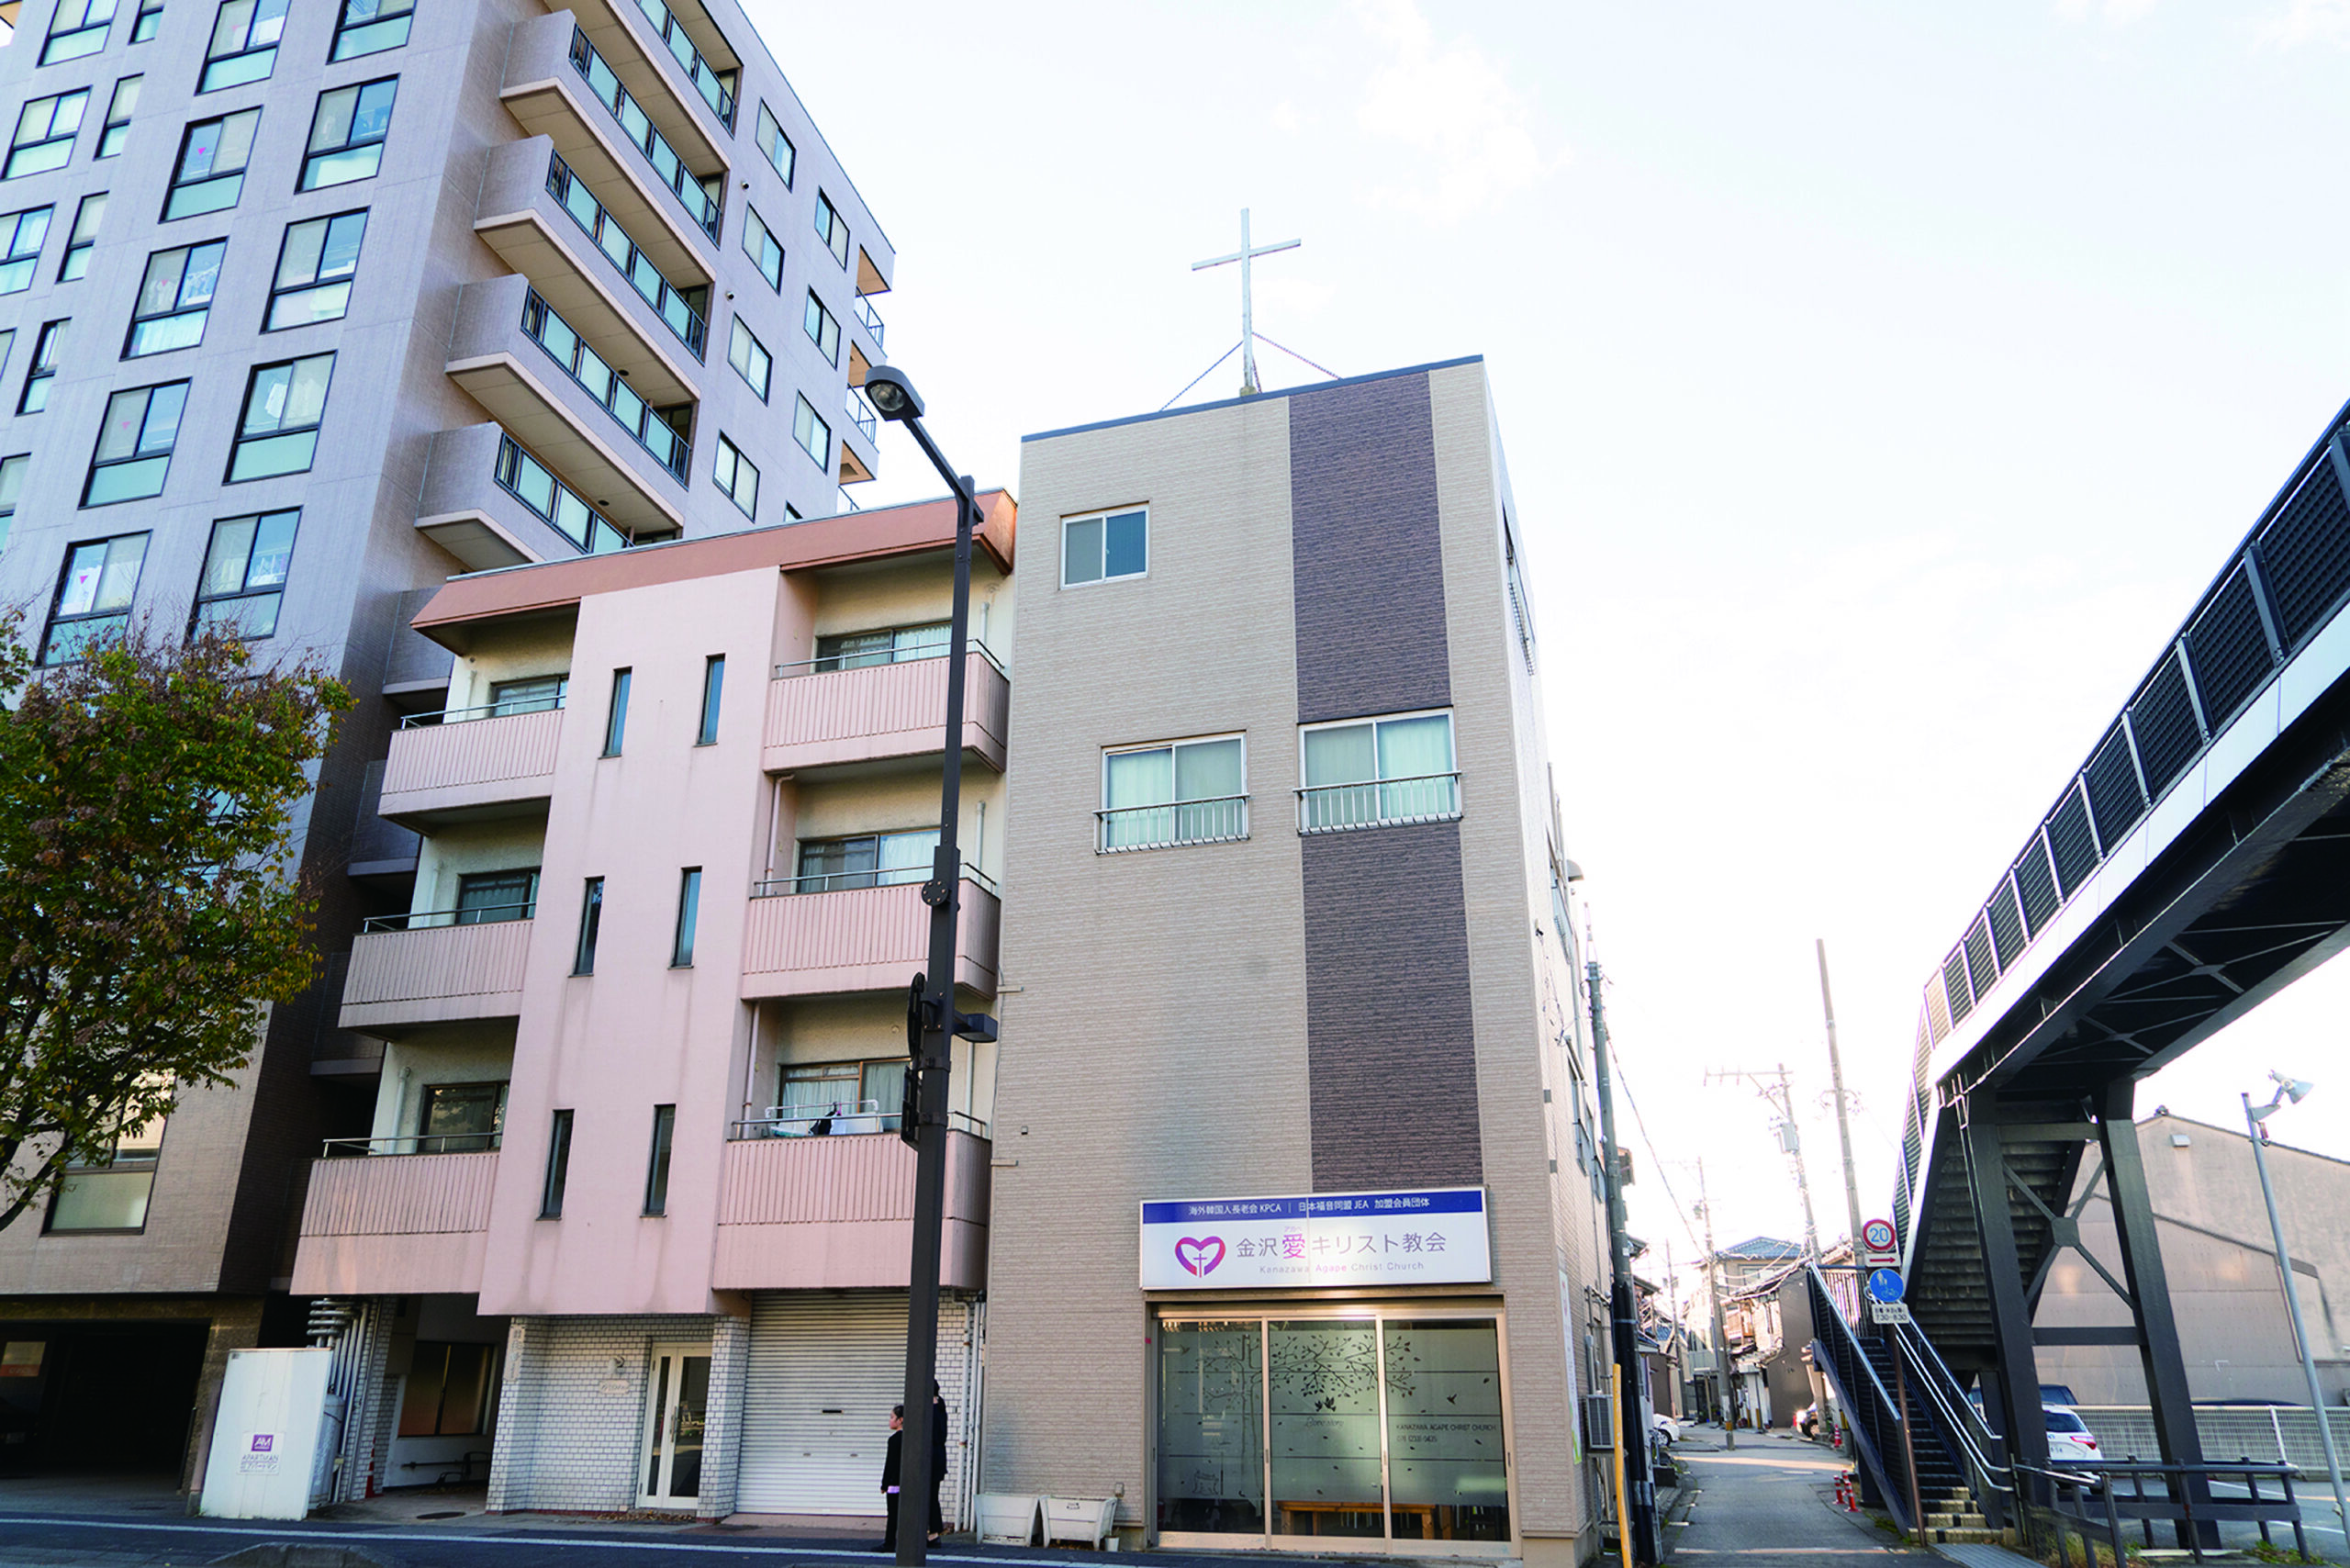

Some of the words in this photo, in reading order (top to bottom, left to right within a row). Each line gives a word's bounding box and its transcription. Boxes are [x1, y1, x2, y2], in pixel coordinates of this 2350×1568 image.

[1259, 1203, 1282, 1213] KPCA
[1298, 1200, 1352, 1212] 日本福音同盟
[1354, 1200, 1370, 1210] JEA
[1374, 1197, 1430, 1209] 加盟会員団体
[1869, 1227, 1889, 1242] 20
[1237, 1232, 1447, 1260] 金沢愛キリスト教会
[1259, 1264, 1310, 1274] Kanazawa
[1315, 1263, 1348, 1273] Agape
[1351, 1262, 1383, 1272] Christ
[1387, 1260, 1425, 1271] Church
